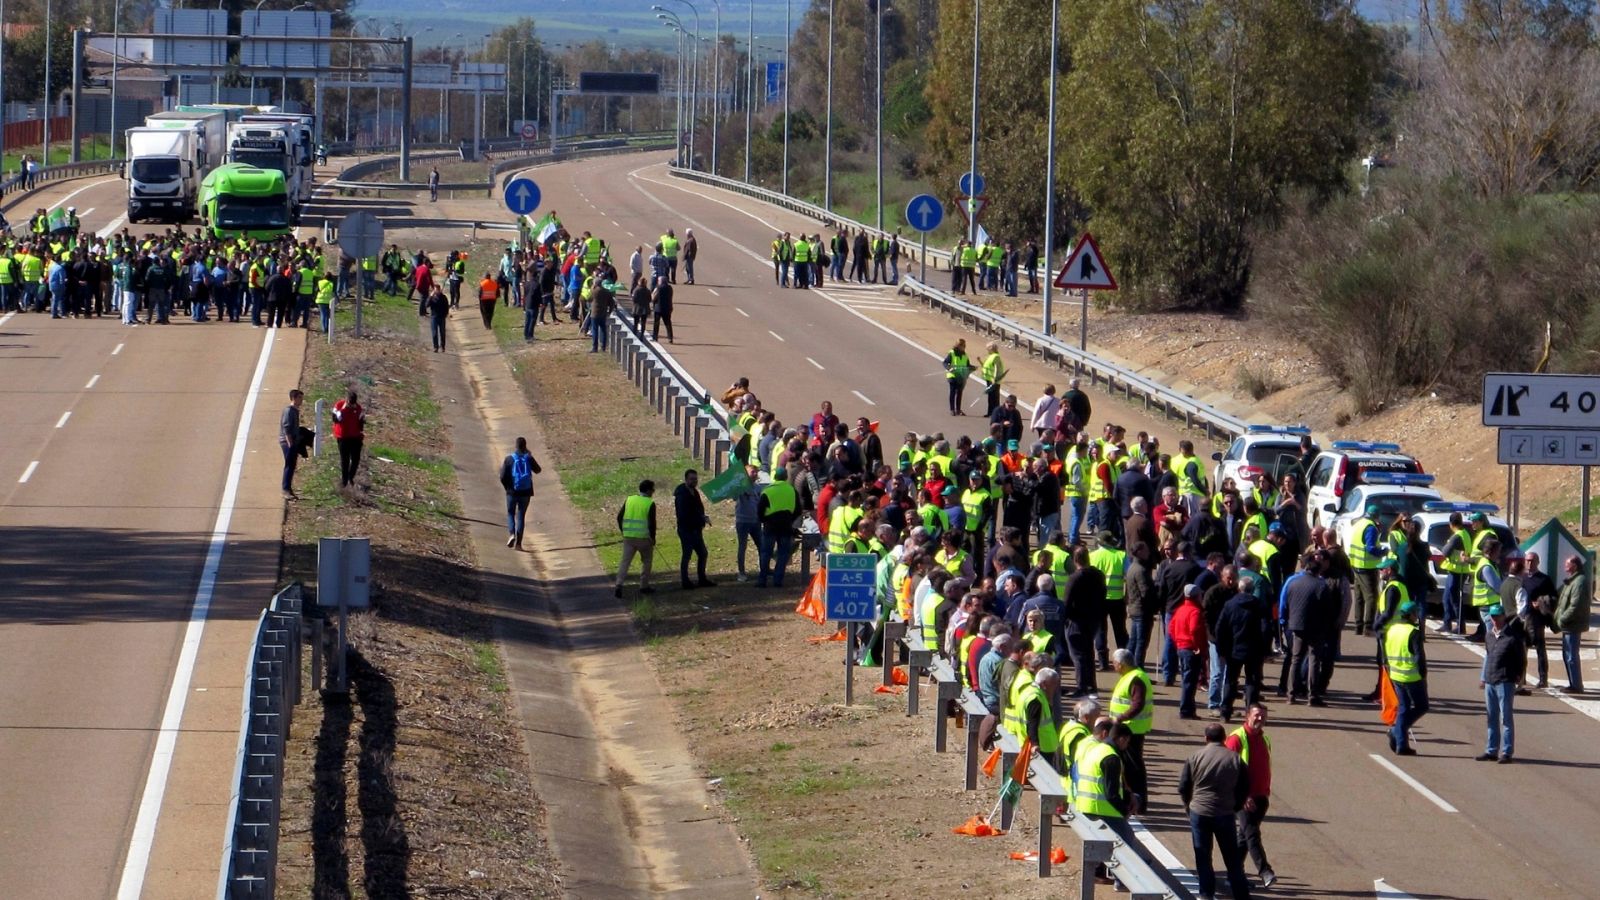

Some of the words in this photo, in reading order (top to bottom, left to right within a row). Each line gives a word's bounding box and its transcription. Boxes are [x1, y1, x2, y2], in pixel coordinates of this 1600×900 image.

[836, 557, 867, 567] E-90
[841, 573, 863, 583] A-5
[843, 590, 859, 598] km
[833, 601, 868, 616] 407
